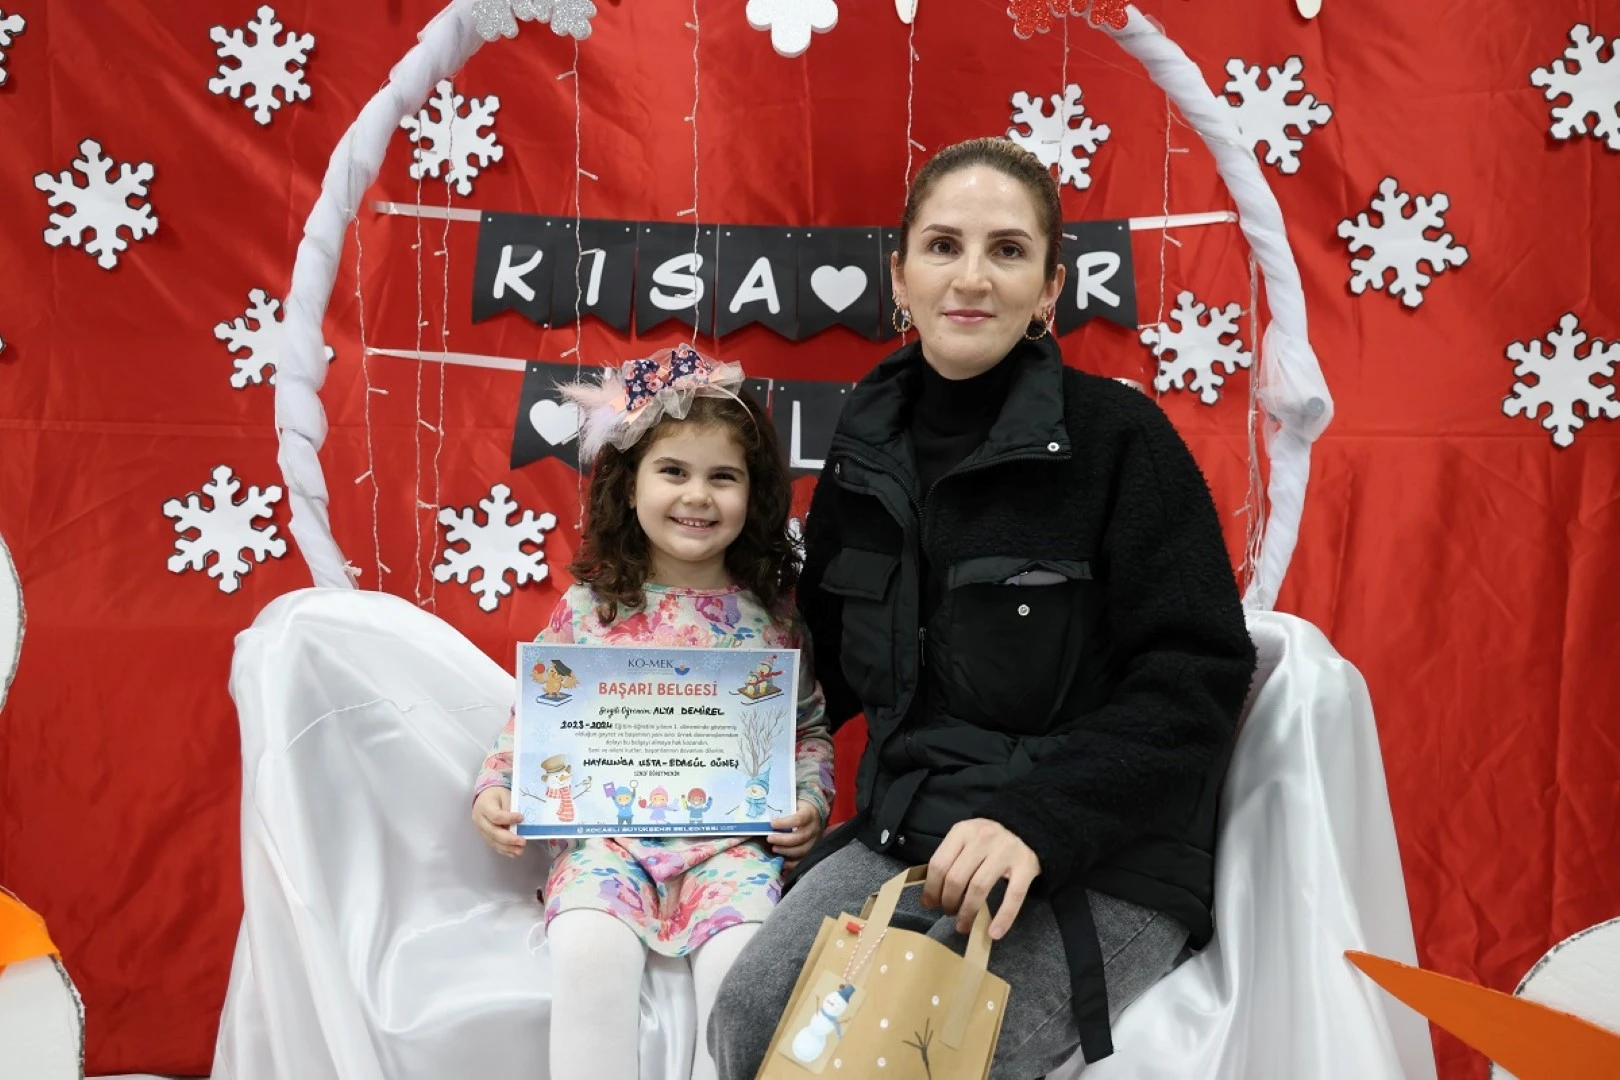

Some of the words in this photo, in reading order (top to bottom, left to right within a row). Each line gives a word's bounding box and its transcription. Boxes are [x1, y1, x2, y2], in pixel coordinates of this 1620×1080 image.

[493, 244, 781, 314] KISA
[628, 659, 674, 669] KO-MEK
[599, 682, 652, 699] BAŞARI
[657, 681, 718, 696] BELGESİ
[653, 706, 675, 716] ALYA
[681, 705, 725, 716] DEMİREL
[560, 720, 613, 730] 2023-2024
